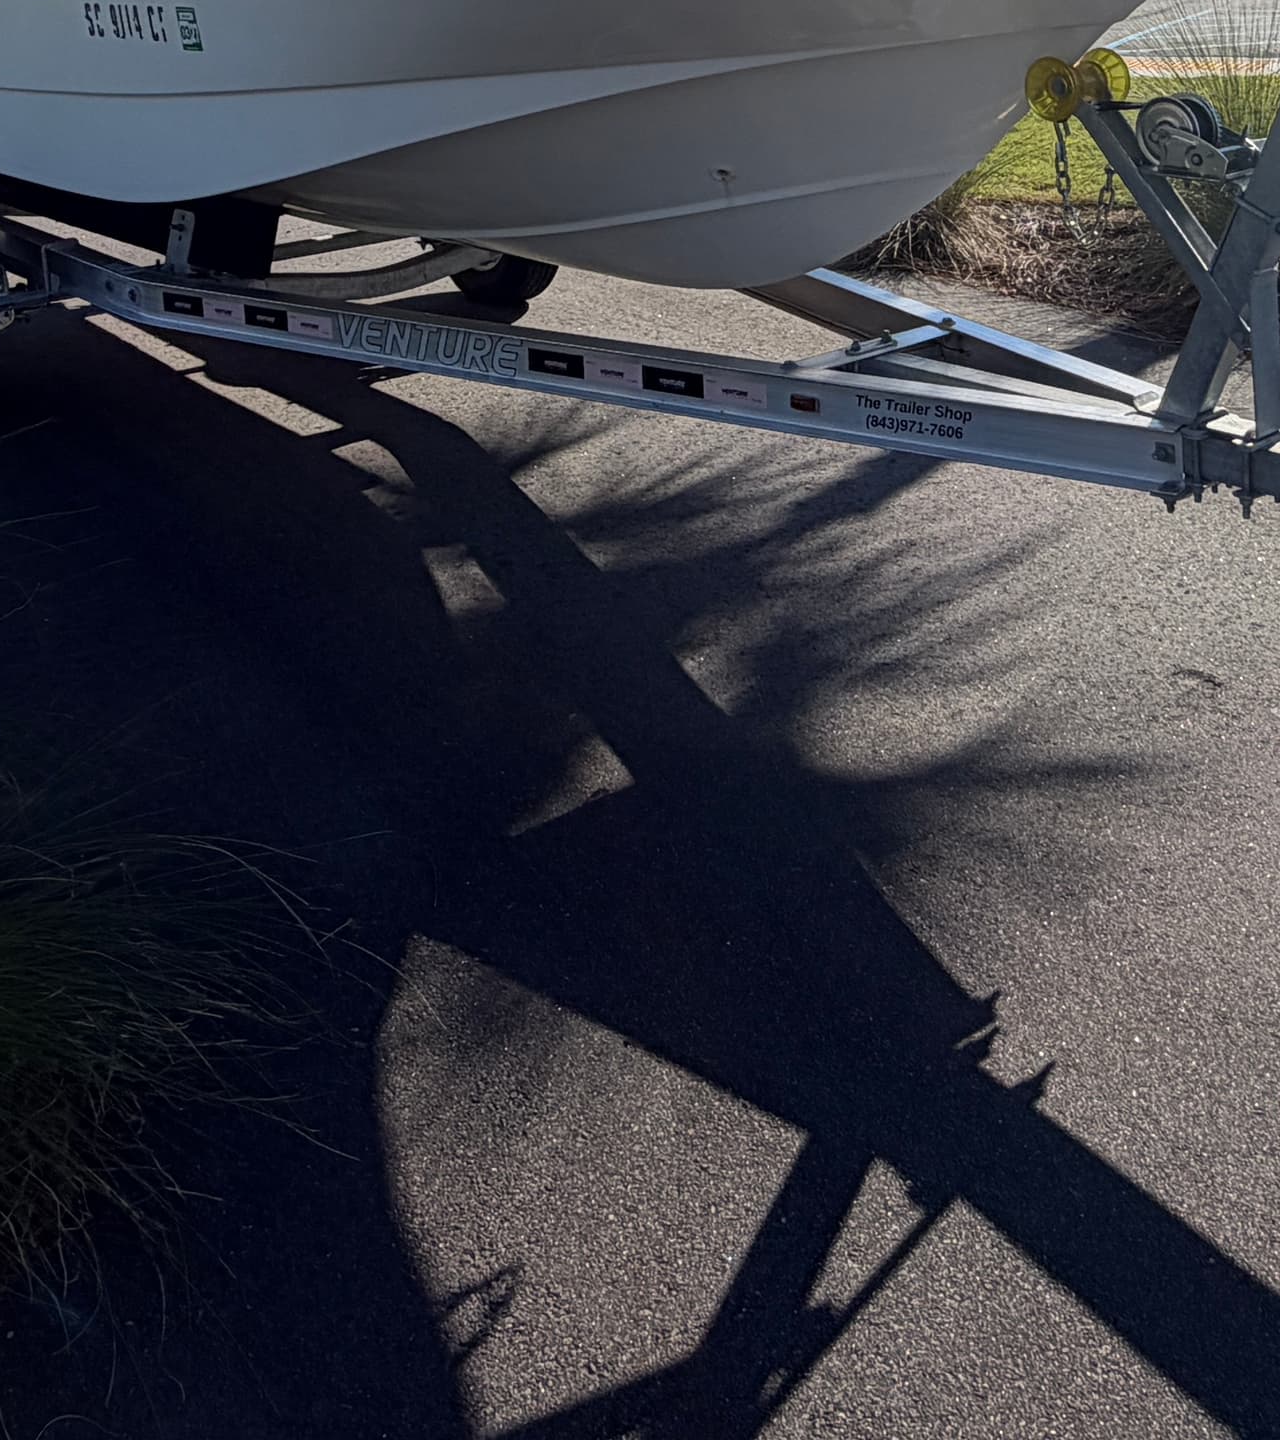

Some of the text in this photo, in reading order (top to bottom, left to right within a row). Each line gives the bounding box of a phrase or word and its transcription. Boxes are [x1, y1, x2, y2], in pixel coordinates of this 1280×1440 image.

[336, 313, 524, 378] VENTURE
[856, 394, 973, 425] The Trailer Shop
[865, 413, 964, 440] (843)971-7606
